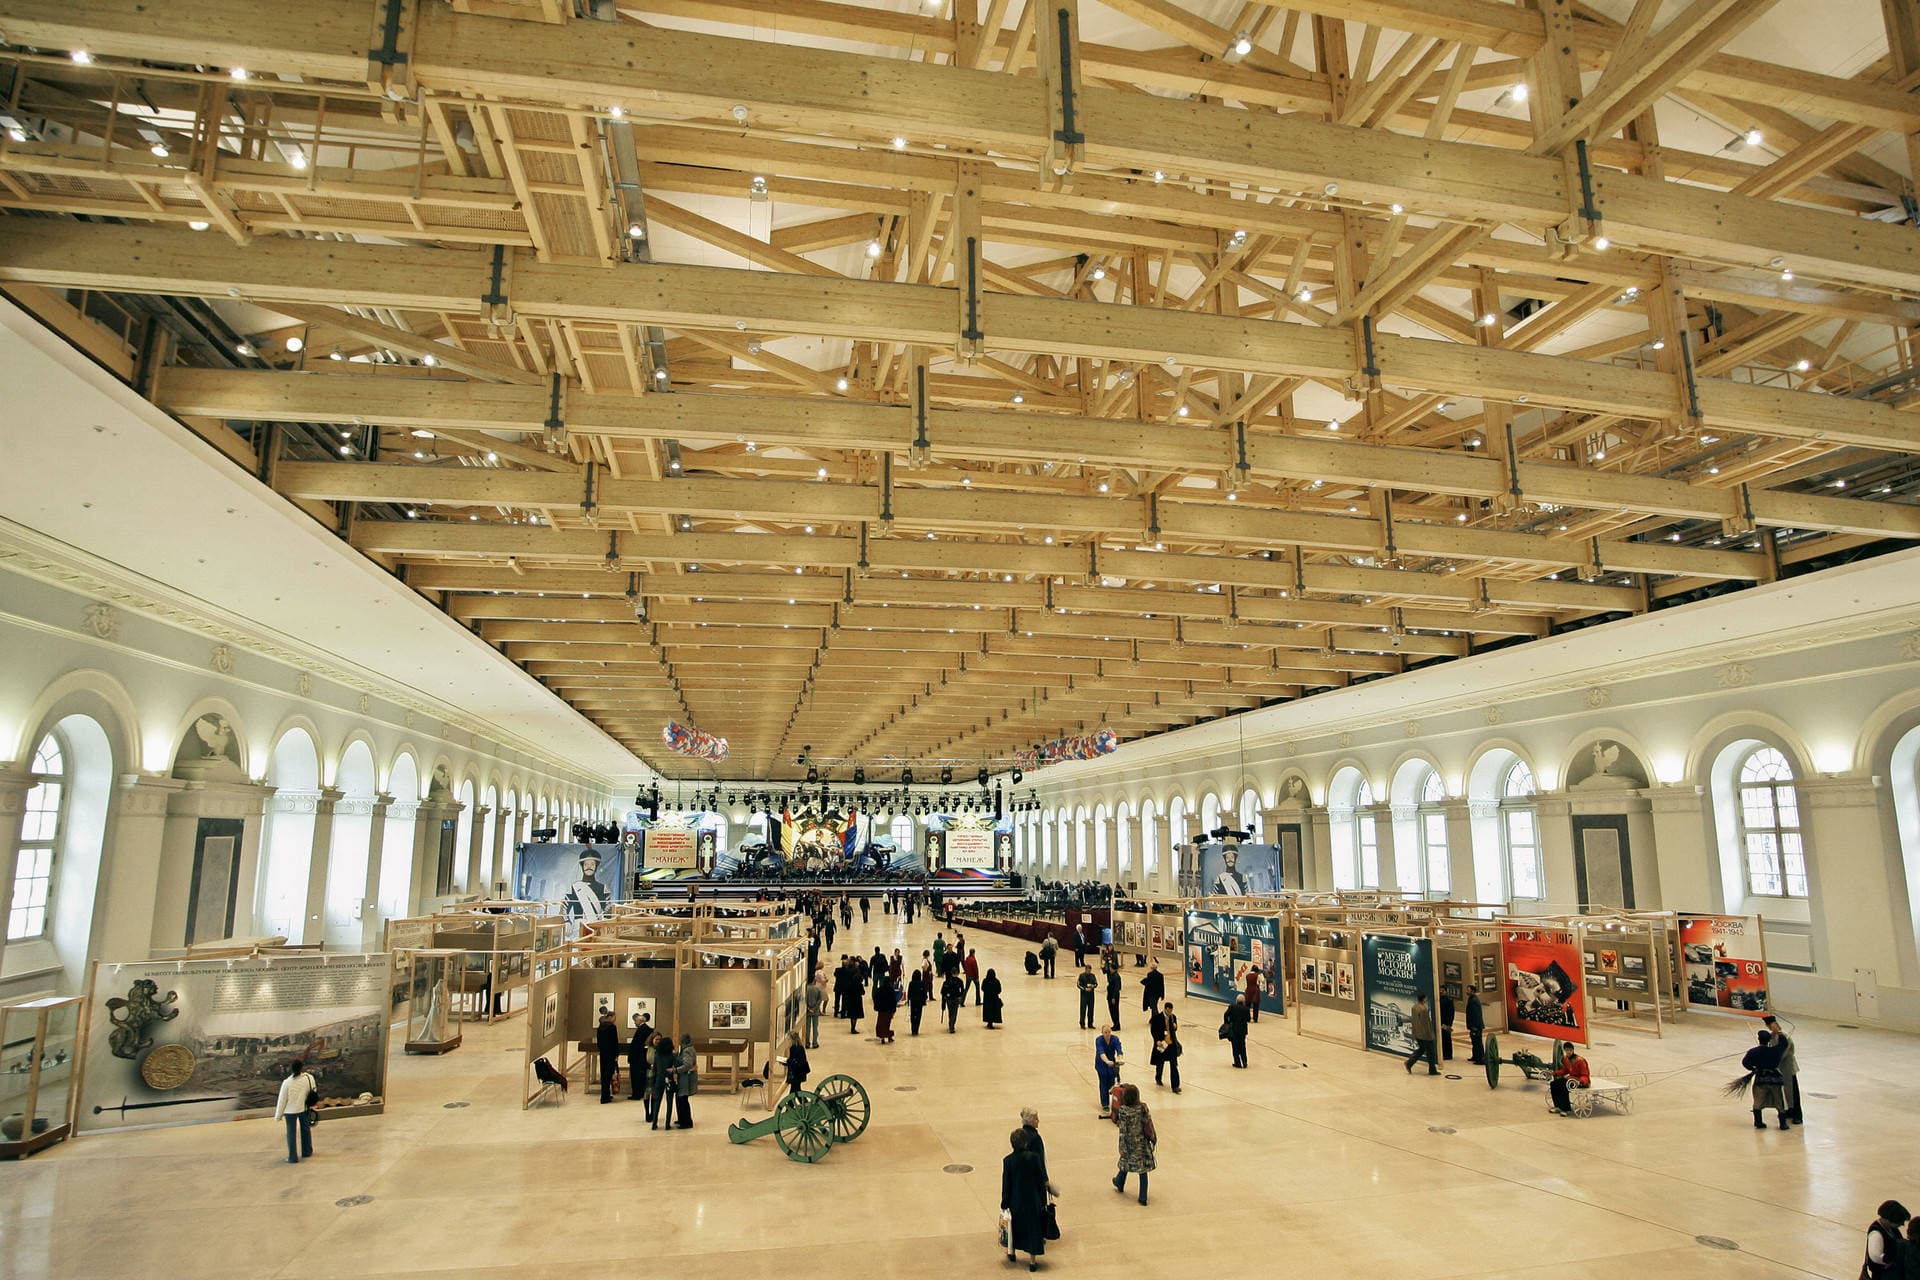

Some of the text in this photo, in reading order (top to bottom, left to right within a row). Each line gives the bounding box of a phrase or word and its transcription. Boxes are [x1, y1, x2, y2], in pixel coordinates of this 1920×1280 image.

[1555, 932, 1574, 944] 1917
[1712, 928, 1744, 936] 1941-1945
[1377, 958, 1416, 972] ИСТОРИИ
[1745, 962, 1762, 975] 60
